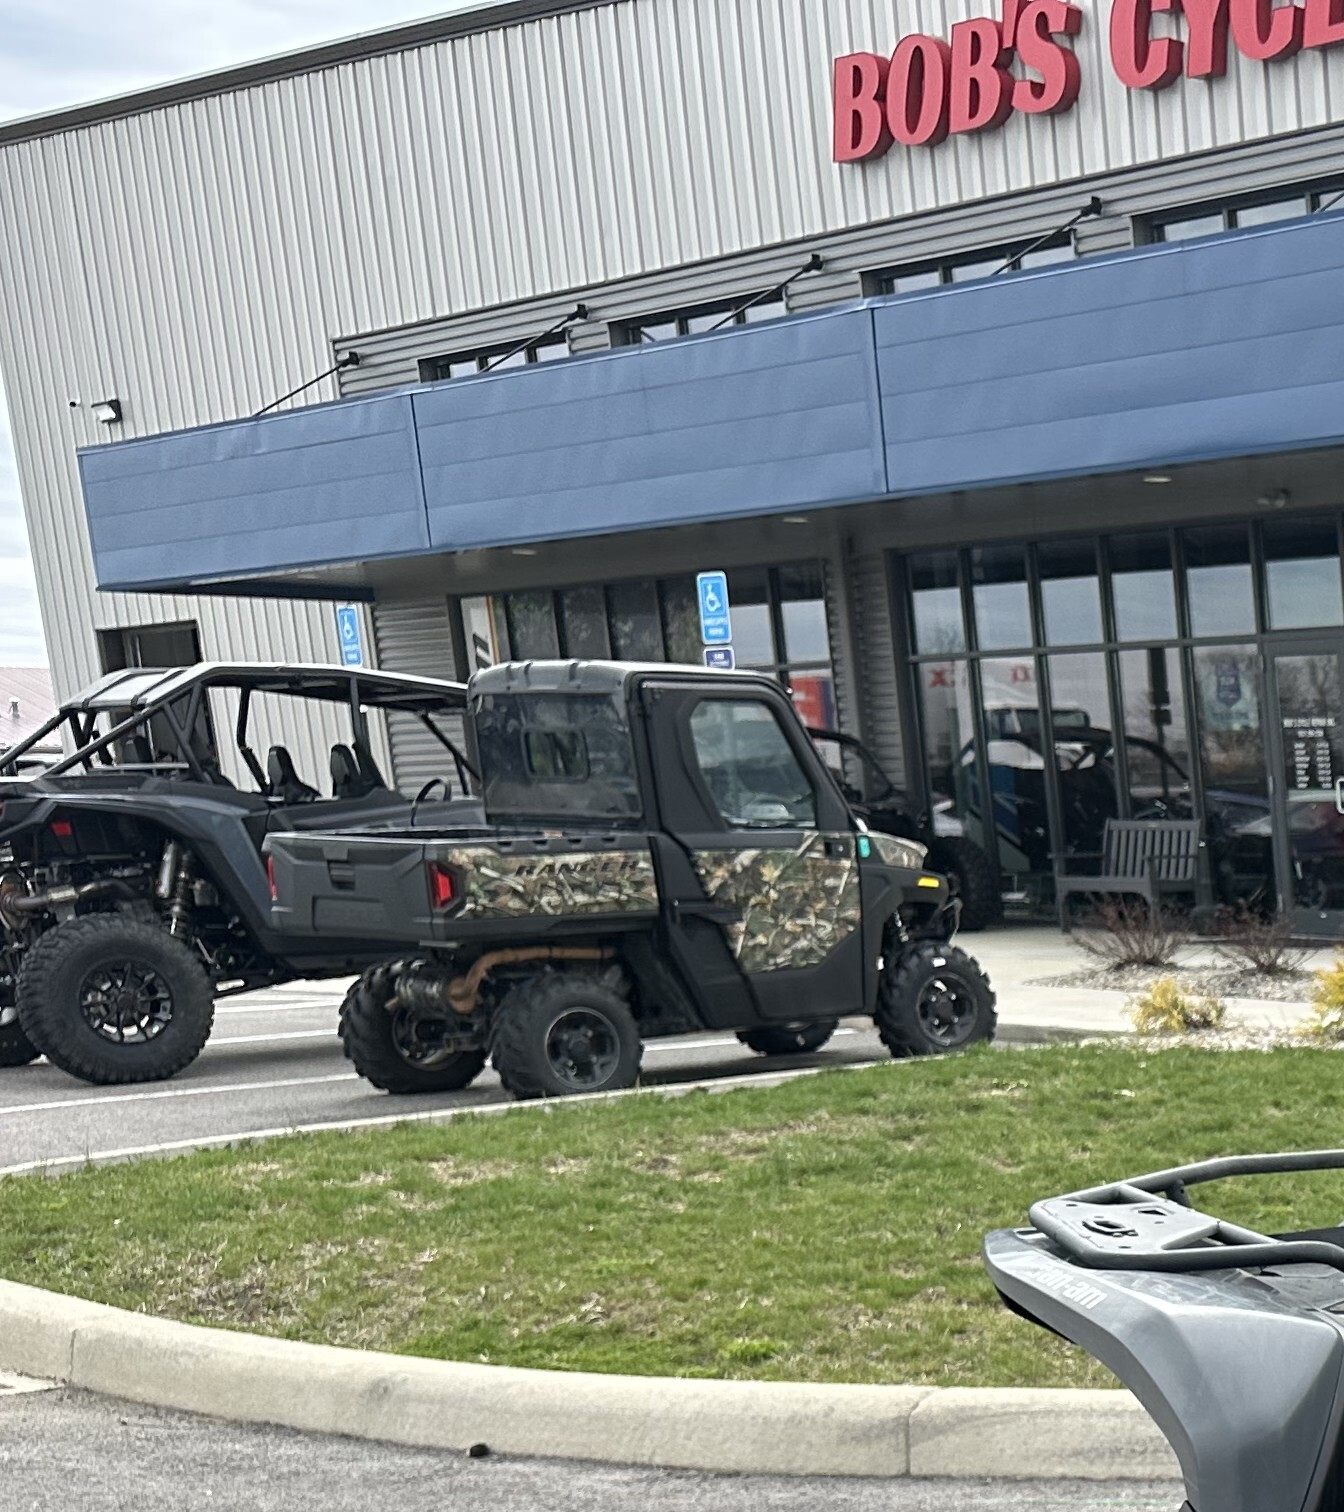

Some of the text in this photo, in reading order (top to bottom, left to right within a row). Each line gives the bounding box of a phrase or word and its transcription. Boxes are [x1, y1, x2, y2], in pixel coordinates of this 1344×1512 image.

[833, 0, 1082, 163] BOB'S
[516, 861, 640, 876] RANGER
[1026, 1264, 1108, 1310] can-am
